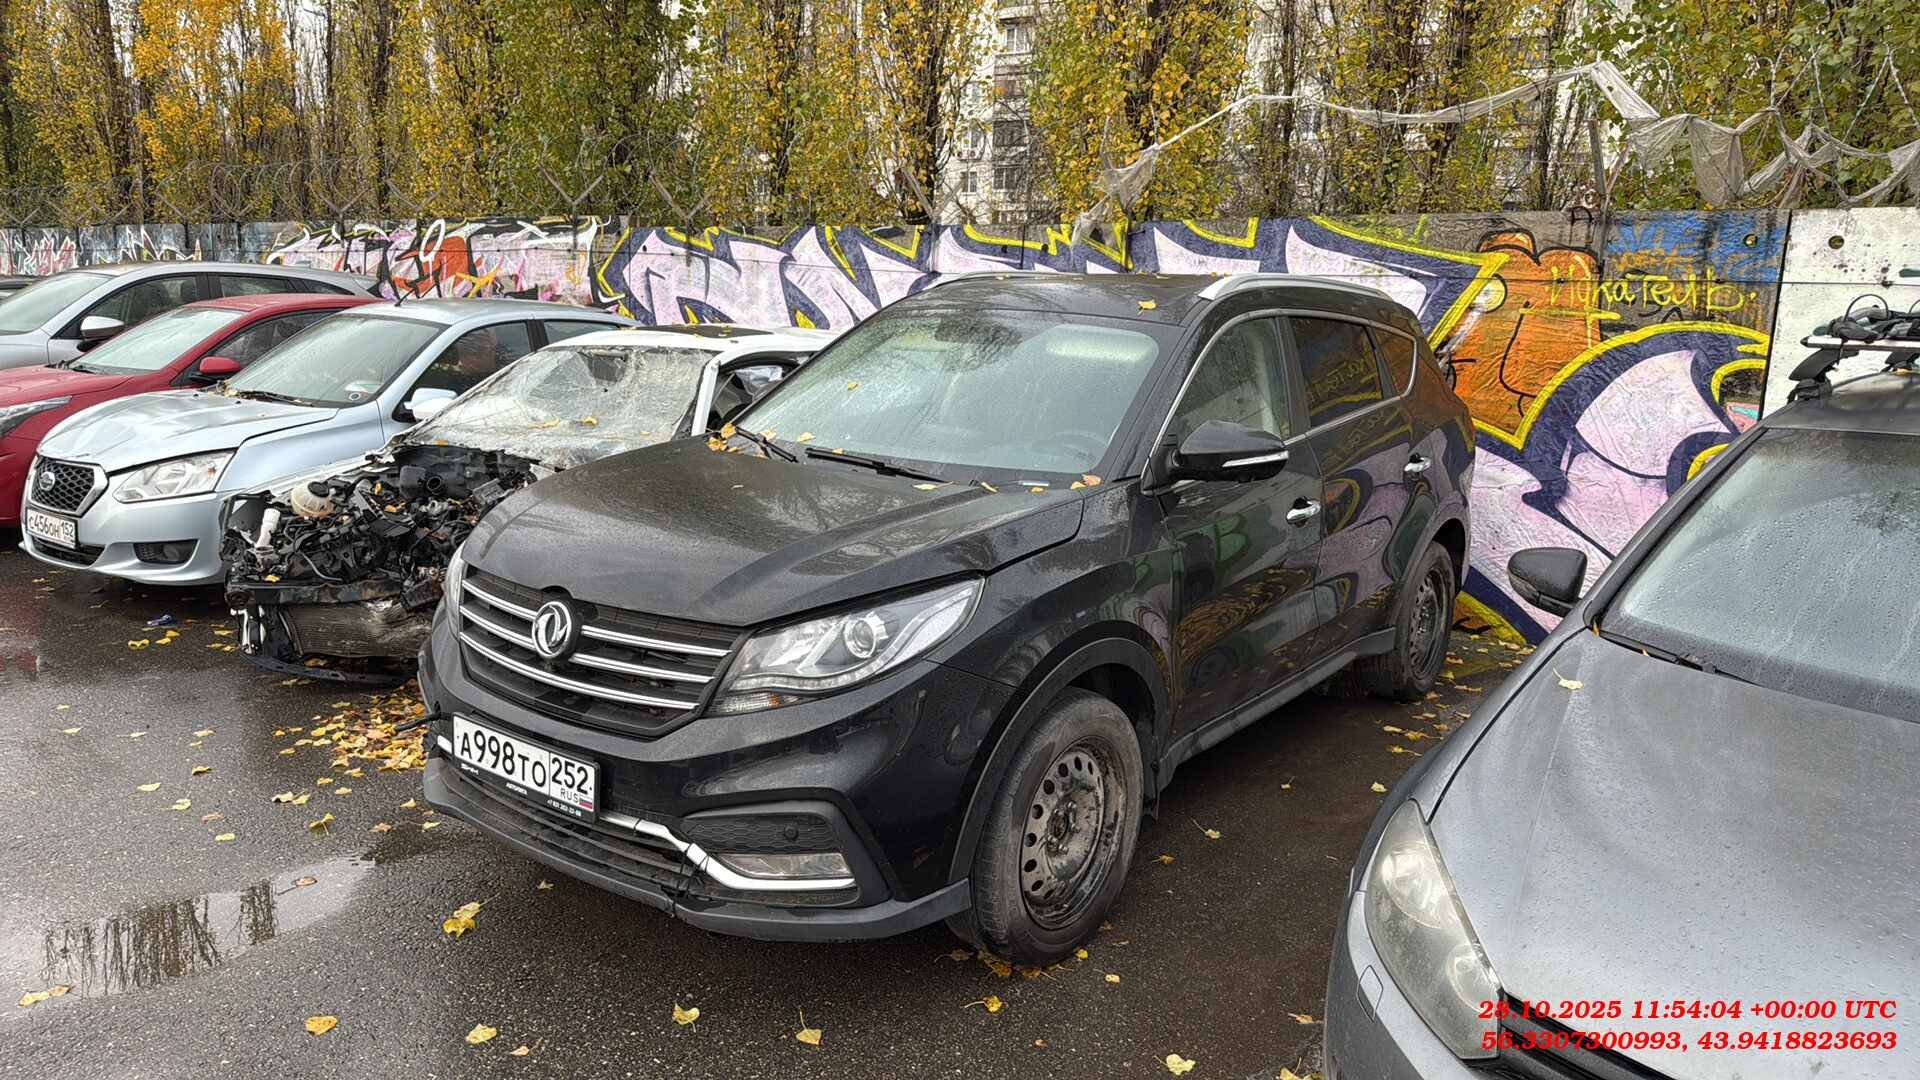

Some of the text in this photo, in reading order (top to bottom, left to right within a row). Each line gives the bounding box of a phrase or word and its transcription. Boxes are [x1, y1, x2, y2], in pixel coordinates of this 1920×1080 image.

[61, 519, 74, 538] 152
[460, 730, 589, 795] А998ТО 252
[560, 788, 579, 804] RUS
